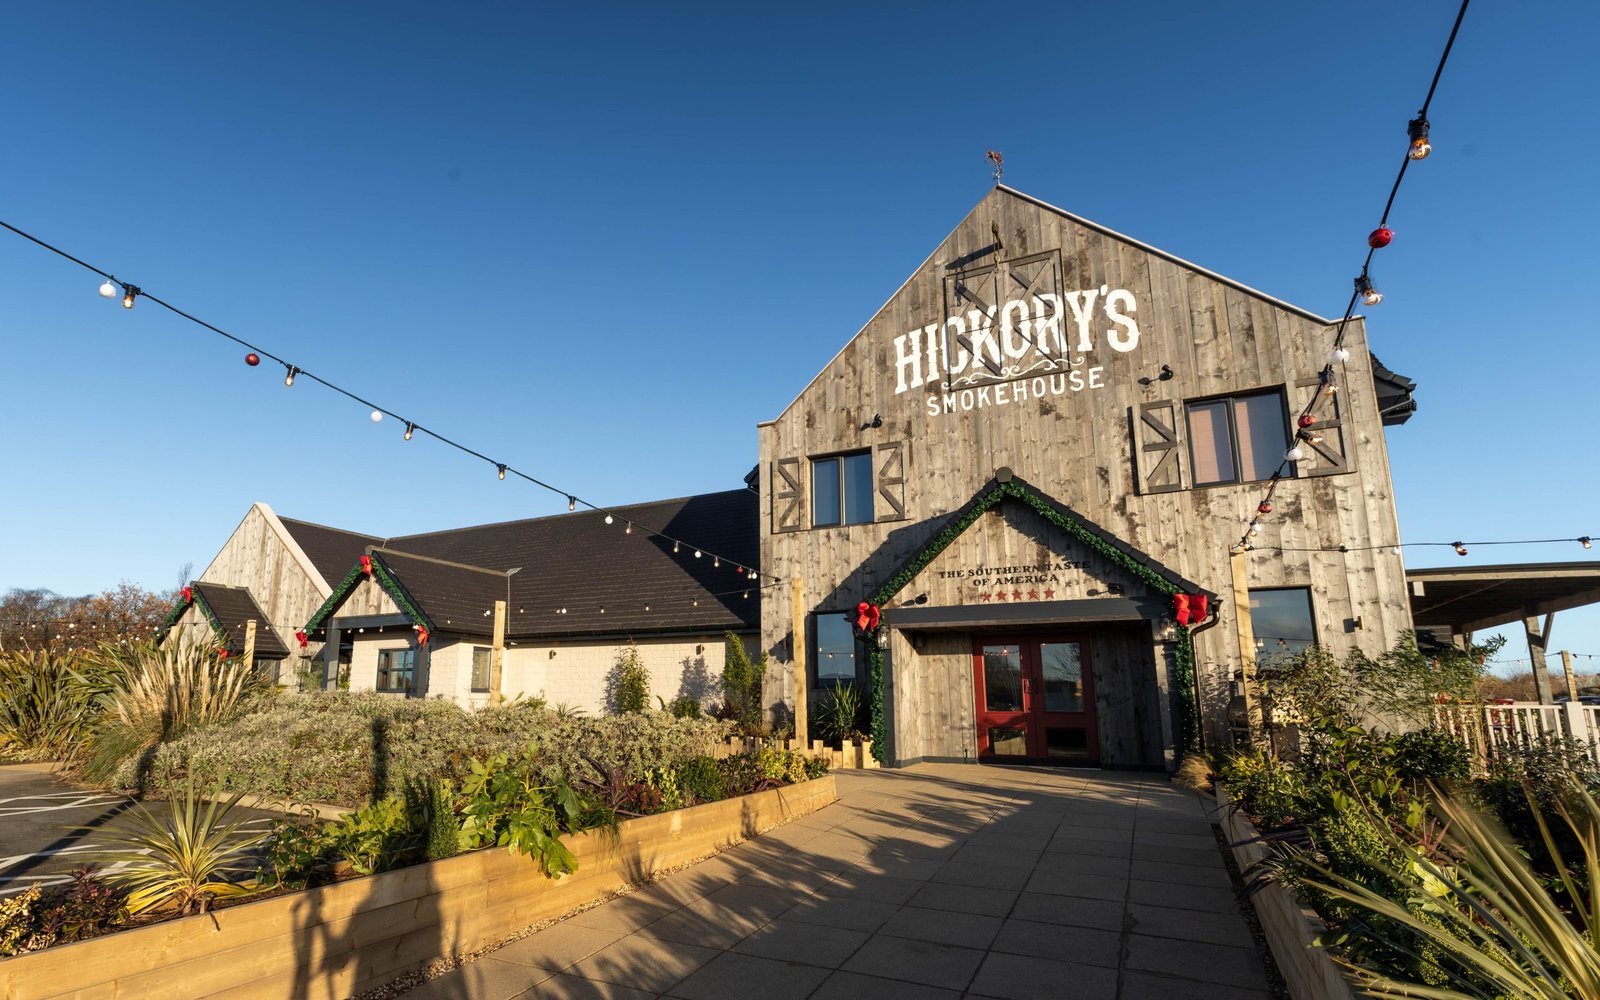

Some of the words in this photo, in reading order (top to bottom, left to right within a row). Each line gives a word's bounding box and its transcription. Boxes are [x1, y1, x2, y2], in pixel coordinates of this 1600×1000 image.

[893, 284, 1141, 395] HICKORY'S
[927, 366, 1105, 417] SMOKEHOUSE
[938, 569, 965, 579] THE
[967, 564, 1042, 577] SOUTHERN
[1045, 560, 1091, 571] TASTE
[973, 578, 988, 587] OF
[993, 573, 1059, 586] AMERICA
